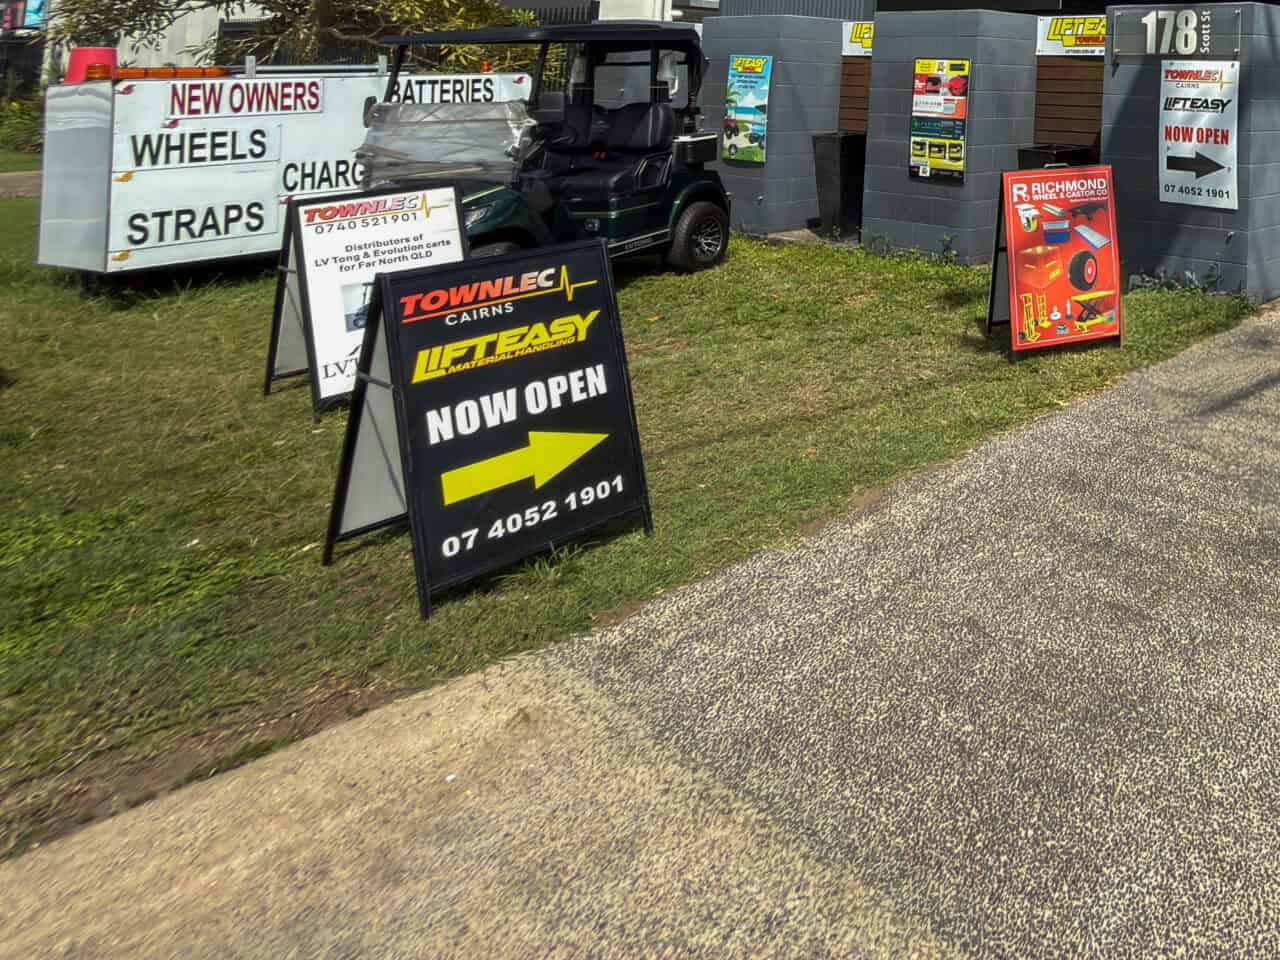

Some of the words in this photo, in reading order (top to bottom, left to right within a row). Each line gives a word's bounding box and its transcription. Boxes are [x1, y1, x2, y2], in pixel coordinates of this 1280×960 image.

[1200, 10, 1210, 21] St
[1141, 9, 1198, 55] 178
[1200, 24, 1210, 53] Scott
[1164, 68, 1219, 82] TOWNLEC
[170, 84, 224, 116] NEW
[229, 80, 320, 113] OWNERS
[390, 78, 495, 105] BATTERIES
[1163, 96, 1232, 114] LIFTEASY
[131, 129, 267, 167] WHEELS
[1164, 125, 1194, 143] NOW
[1197, 127, 1230, 144] OPEN
[1031, 178, 1107, 194] RICHMOND
[1032, 191, 1057, 201] WHEEL
[1164, 184, 1175, 194] 07
[1178, 185, 1203, 197] 4052
[1206, 187, 1231, 200] 1901
[304, 195, 419, 223] TOWNLEC
[127, 201, 265, 246] STRAPS
[314, 258, 330, 268] LV
[331, 253, 361, 264] Tong
[373, 243, 424, 257] Evolution
[425, 239, 451, 249] carts
[345, 236, 411, 253] Distributors
[413, 233, 424, 242] of
[339, 263, 356, 273] for
[358, 259, 376, 271] Far
[378, 253, 409, 267] North
[410, 250, 433, 261] QLD
[400, 267, 556, 317] TOWNLEC
[445, 302, 514, 326] CAIRNS
[411, 310, 600, 384] LIFTEASY
[446, 352, 515, 374] MATERIAL
[514, 335, 576, 357] HANDLING
[425, 388, 518, 445] NOW
[523, 364, 608, 415] OPEN
[441, 528, 479, 558] 07
[487, 500, 558, 540] 4052
[564, 474, 624, 512] 1901
